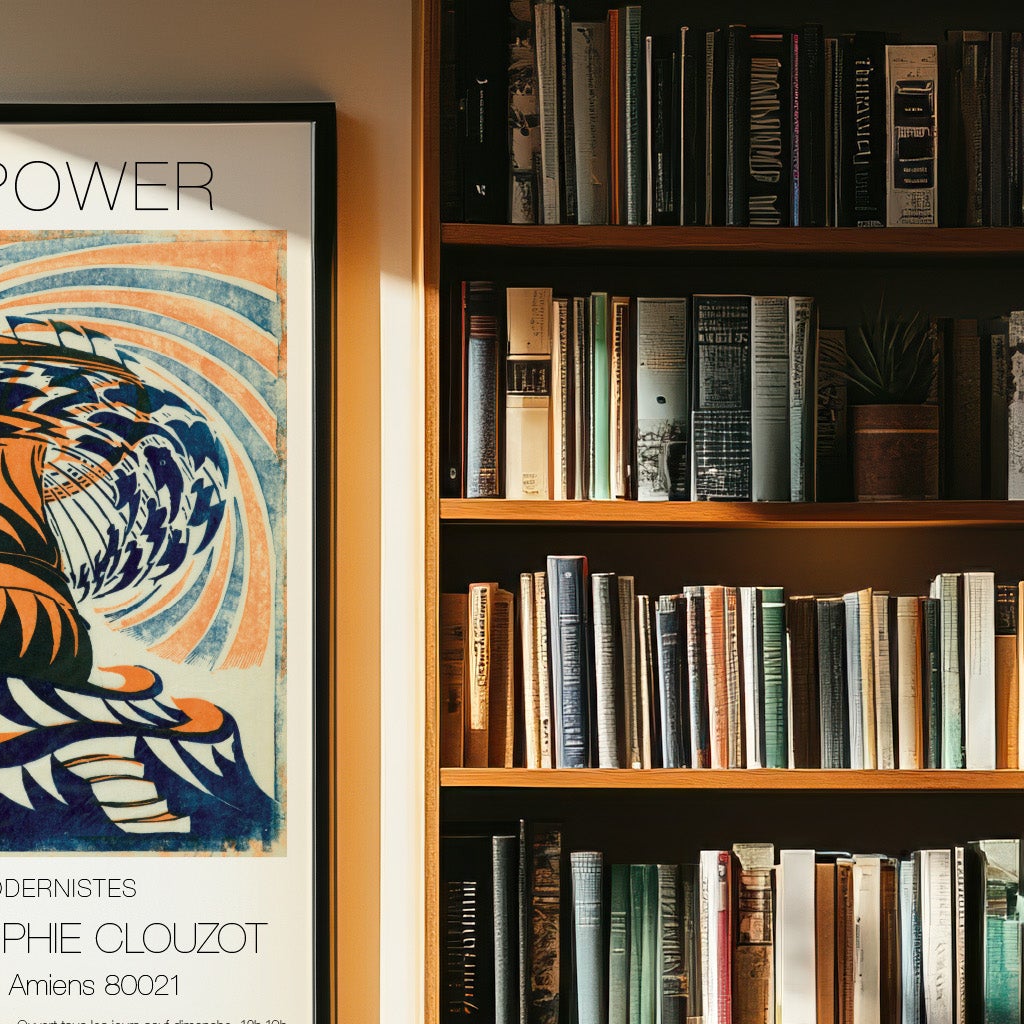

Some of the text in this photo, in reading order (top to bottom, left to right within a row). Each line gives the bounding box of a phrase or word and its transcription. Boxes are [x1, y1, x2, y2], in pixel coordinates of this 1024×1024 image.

[95, 922, 268, 954] CLOUZOT
[8, 974, 95, 996] Amiens
[104, 974, 179, 996] 80021
